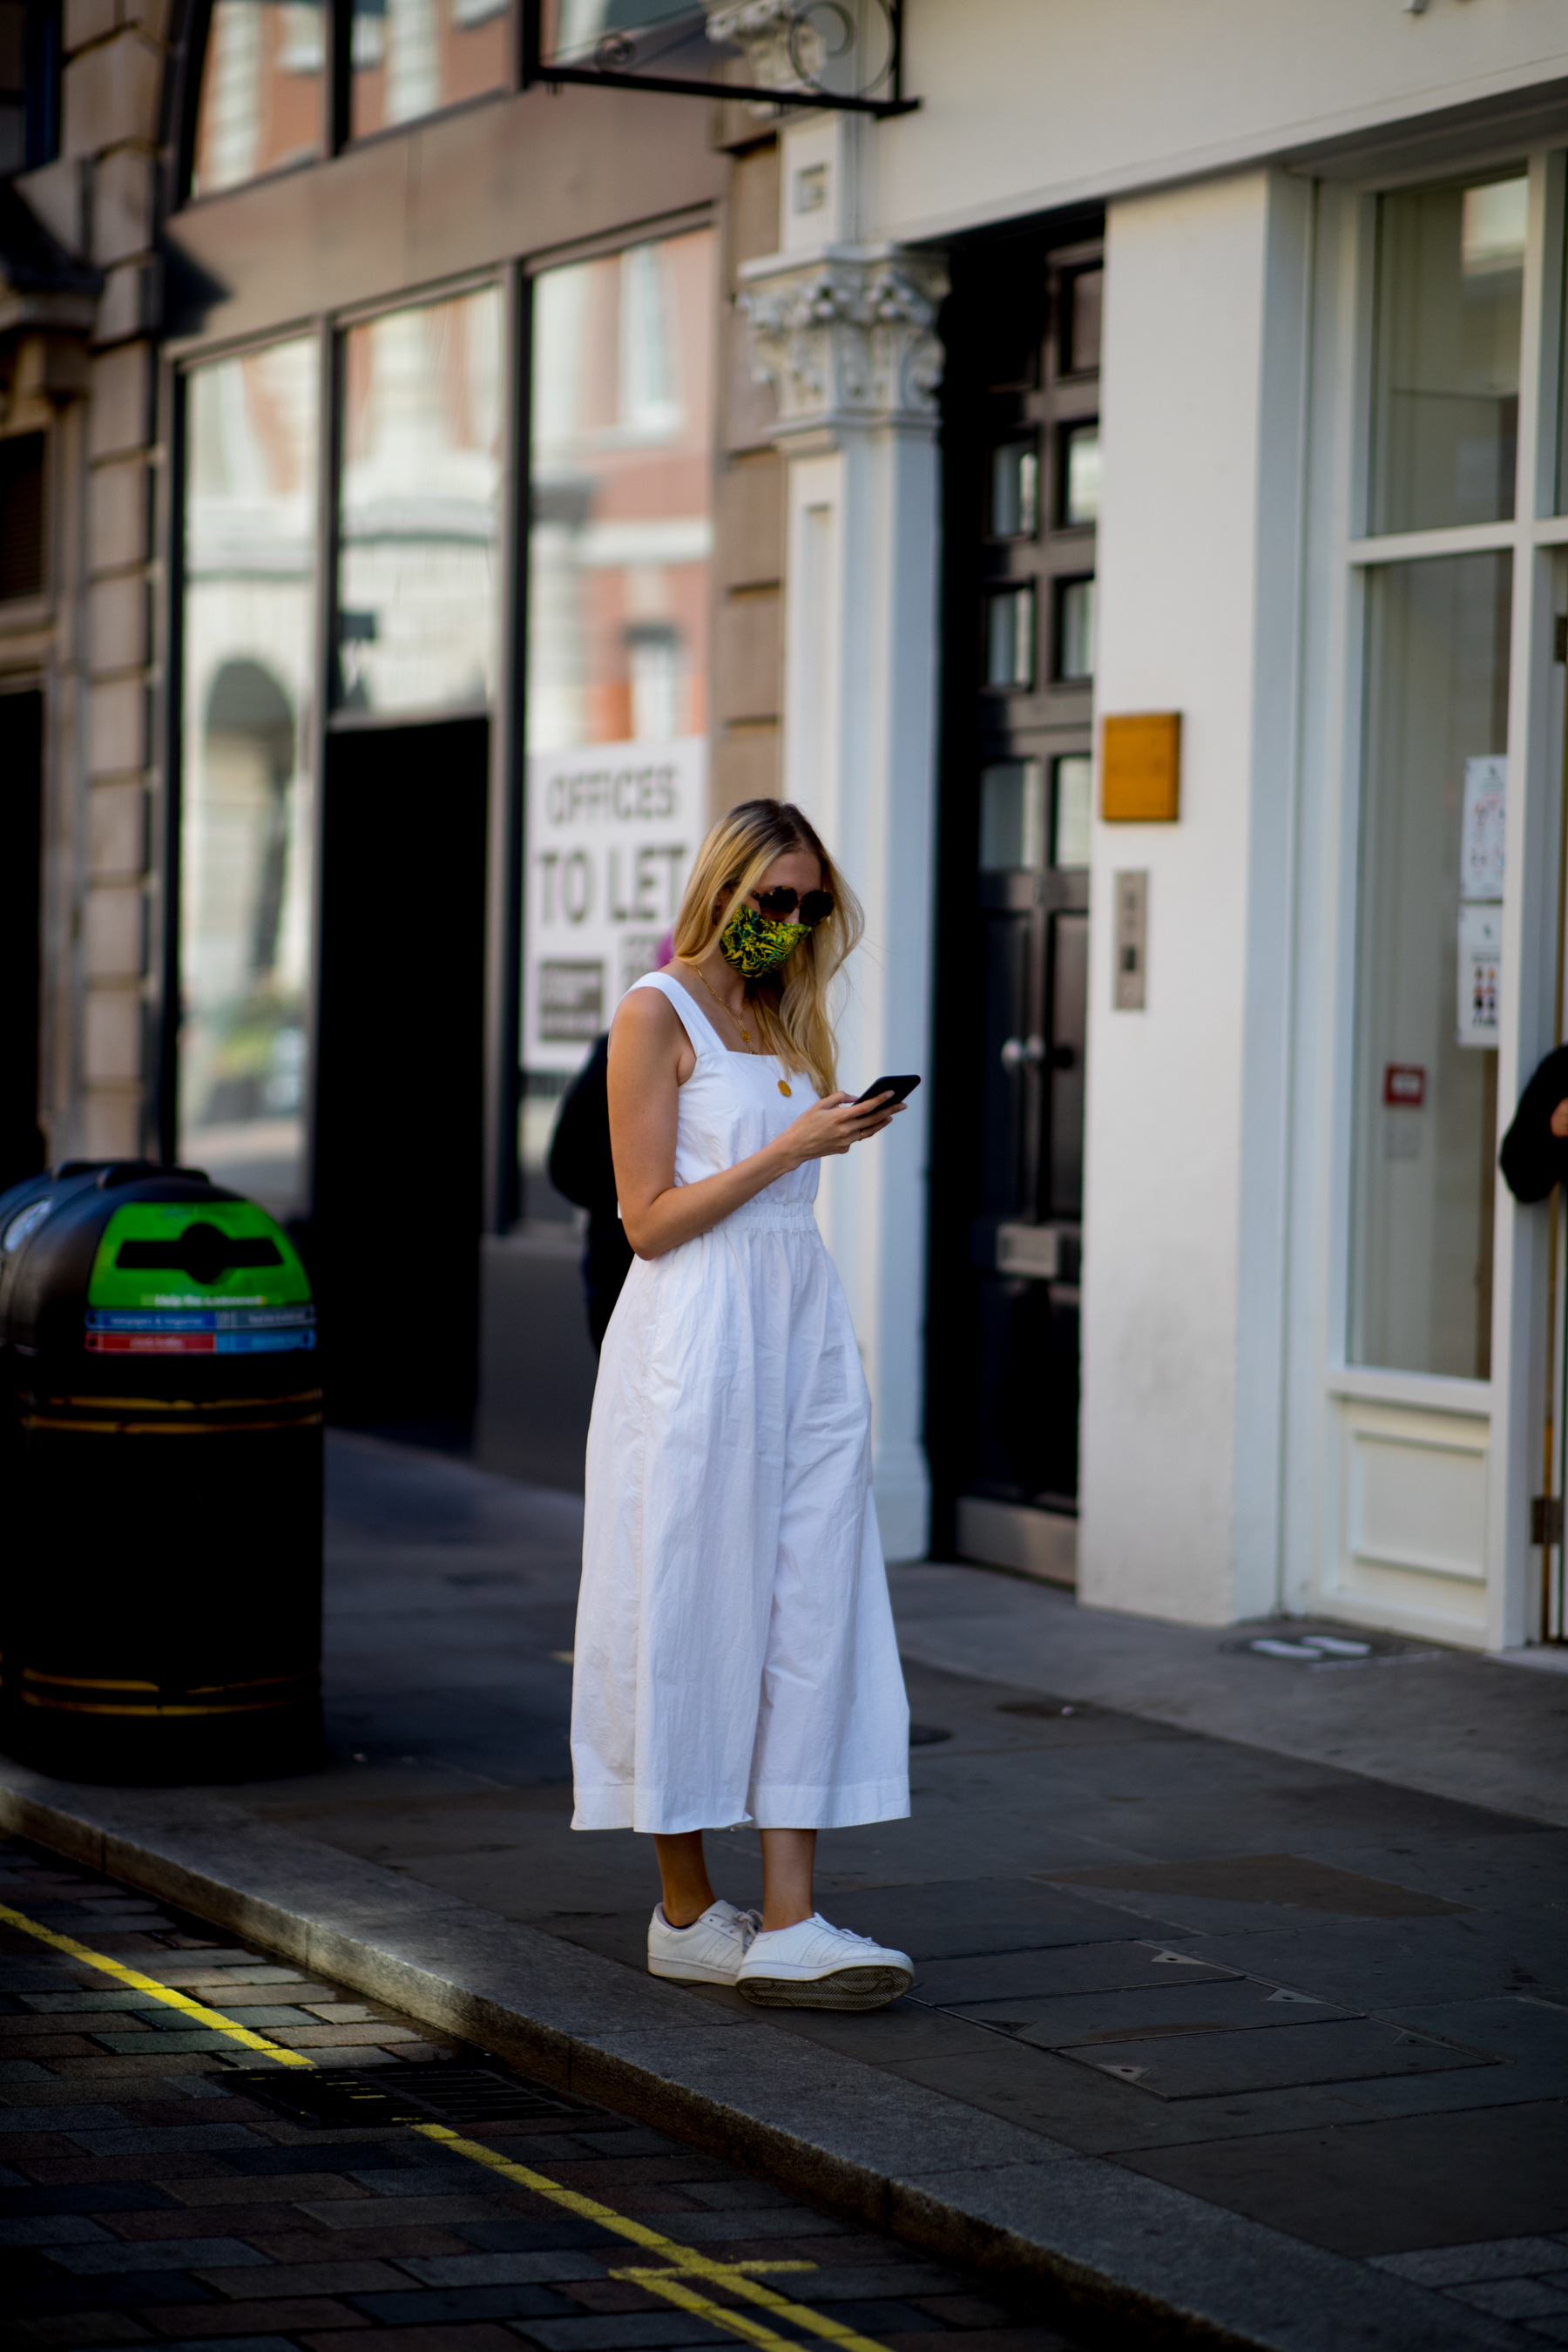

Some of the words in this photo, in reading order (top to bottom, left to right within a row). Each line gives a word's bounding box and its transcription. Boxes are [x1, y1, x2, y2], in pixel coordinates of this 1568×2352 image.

[547, 767, 677, 826] OFFICES
[539, 845, 594, 925] TO
[609, 841, 687, 923] LET
